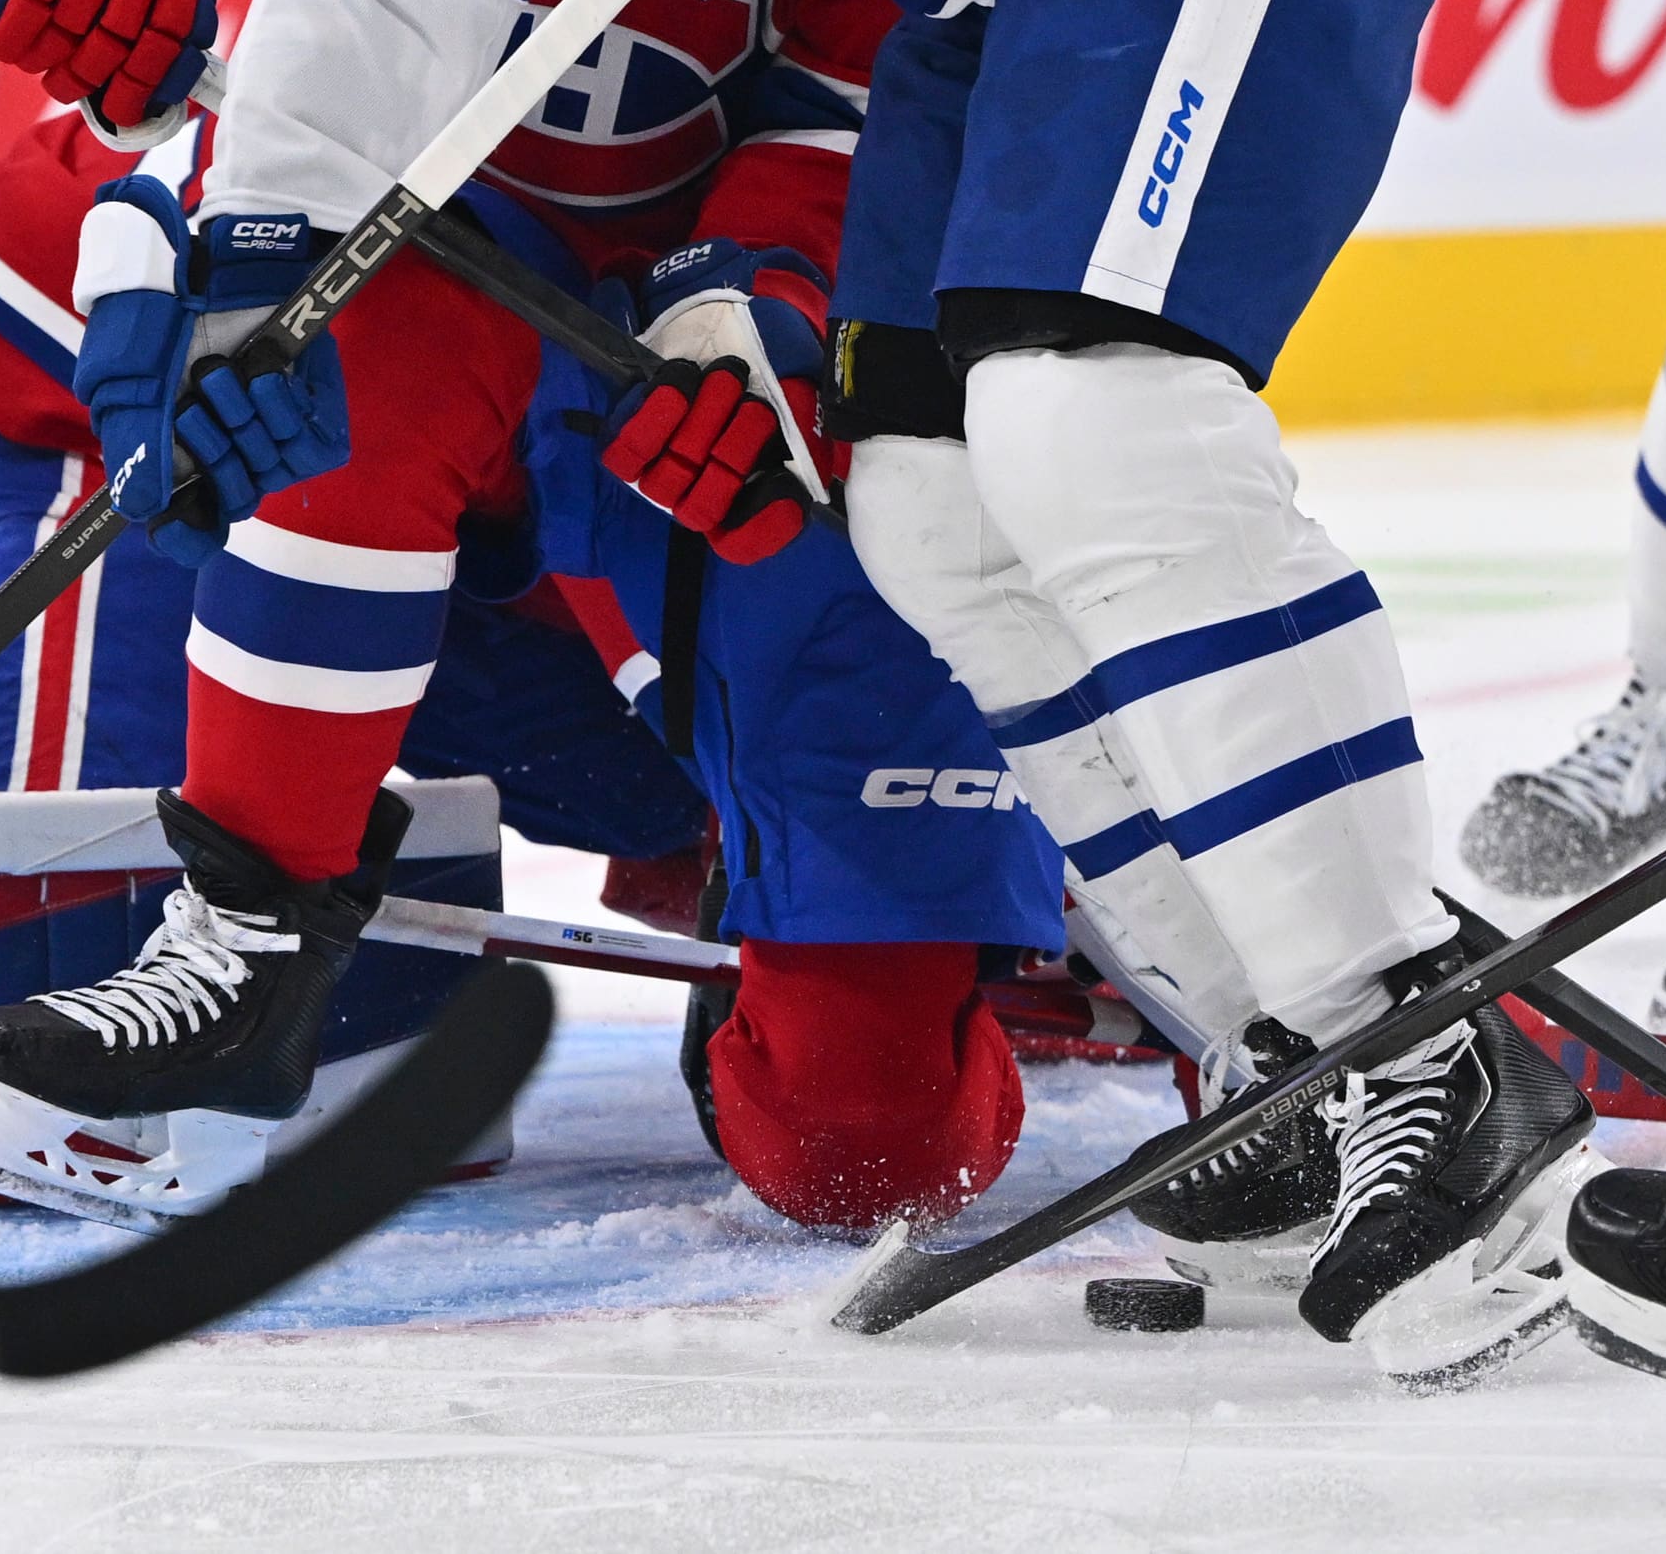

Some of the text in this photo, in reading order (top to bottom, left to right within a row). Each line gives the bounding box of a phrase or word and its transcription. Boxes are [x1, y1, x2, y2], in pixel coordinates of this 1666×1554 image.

[1137, 79, 1205, 229] CCM
[232, 222, 302, 239] CCM
[250, 239, 276, 251] PRO
[651, 243, 713, 278] CCM
[668, 259, 694, 276] PRO
[61, 508, 115, 559] SUPER
